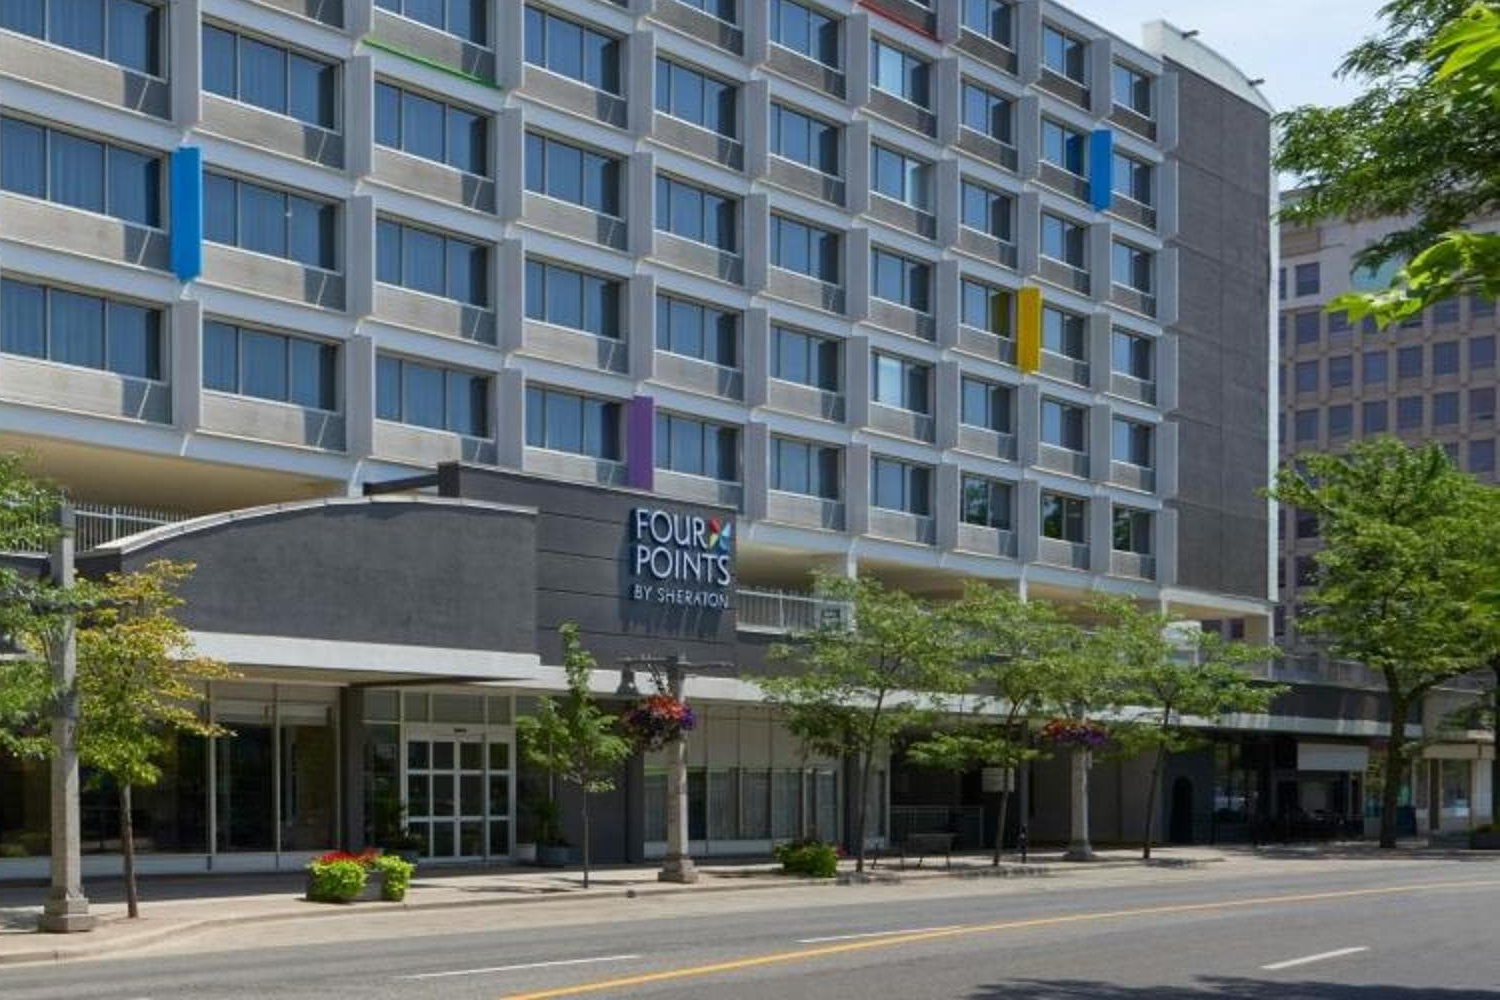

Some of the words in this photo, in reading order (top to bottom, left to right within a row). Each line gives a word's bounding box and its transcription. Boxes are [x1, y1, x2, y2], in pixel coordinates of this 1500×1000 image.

[635, 508, 709, 549] FOUR
[636, 544, 731, 585] POINTS
[634, 584, 653, 601] BY
[657, 587, 729, 609] SHERATON
